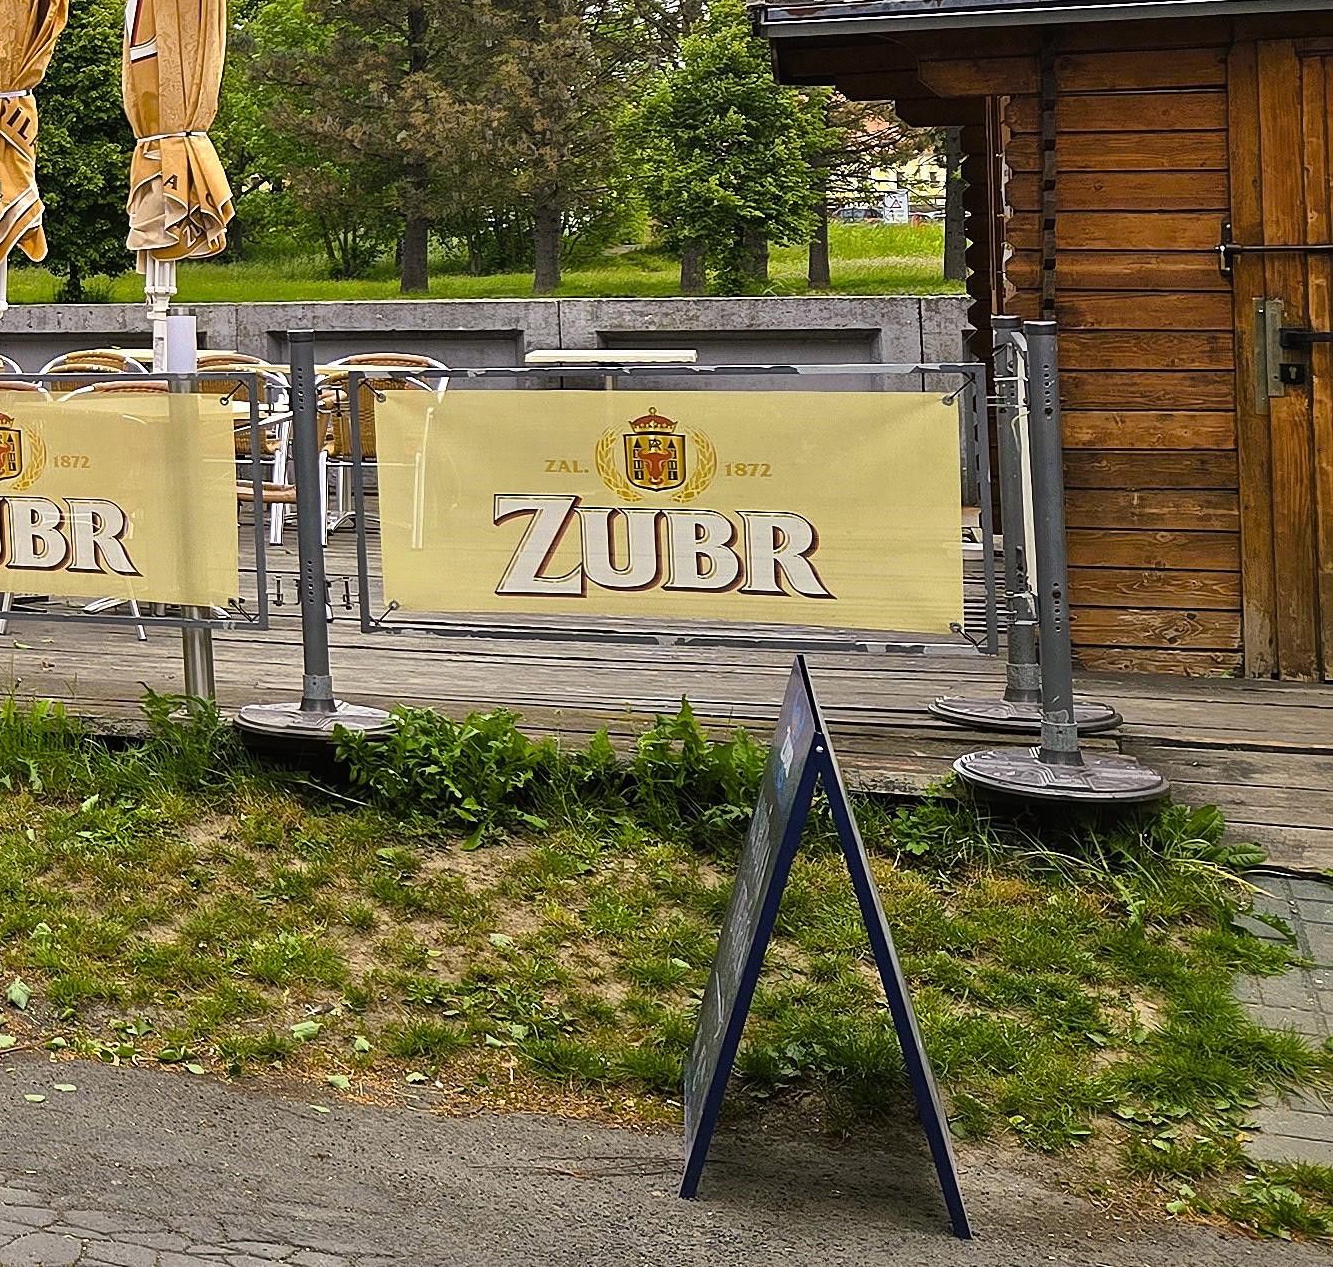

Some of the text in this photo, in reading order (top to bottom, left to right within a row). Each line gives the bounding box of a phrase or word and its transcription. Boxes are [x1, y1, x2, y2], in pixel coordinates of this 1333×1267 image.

[54, 456, 91, 469] 1872
[544, 459, 772, 477] ZAL. 1872
[493, 493, 837, 600] ZUBR
